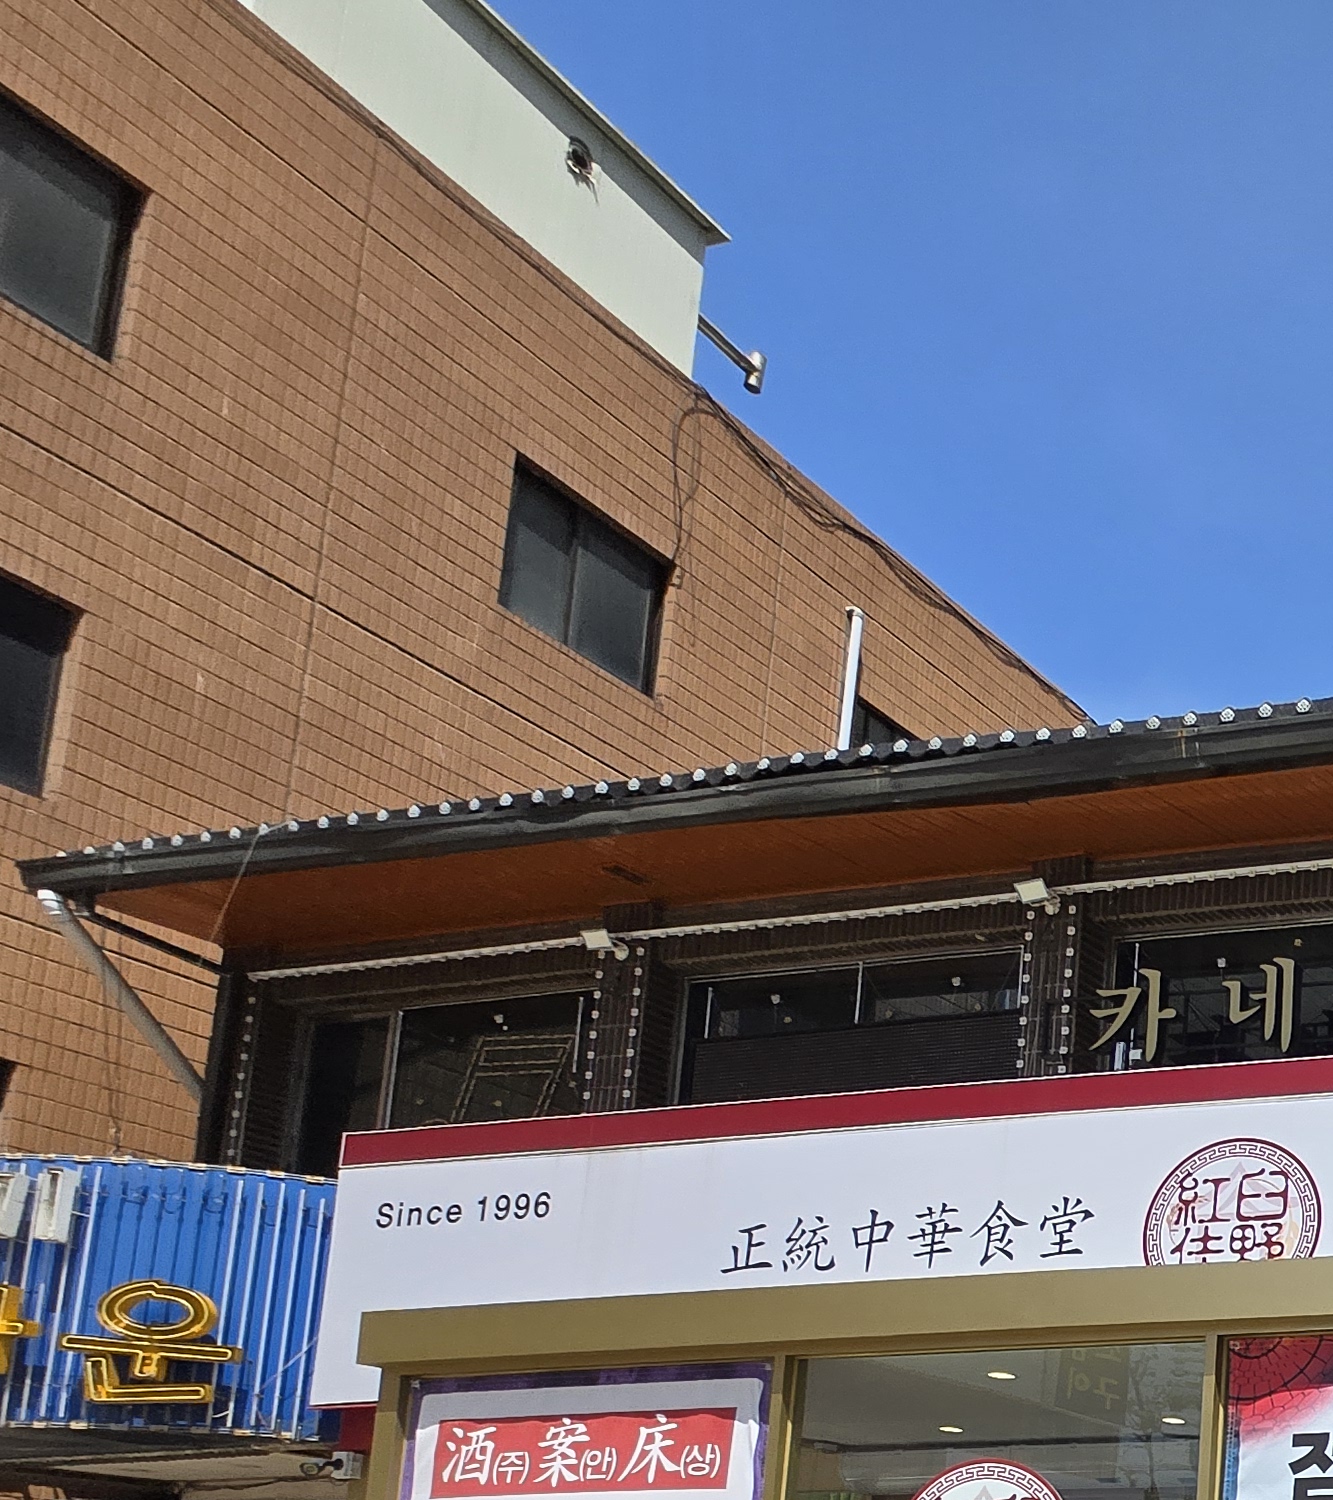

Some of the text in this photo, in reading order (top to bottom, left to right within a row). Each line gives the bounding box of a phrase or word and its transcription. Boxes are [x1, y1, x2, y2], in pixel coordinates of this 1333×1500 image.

[375, 1191, 552, 1230] Since 1996
[719, 1195, 1096, 1275] 正統中華食堂
